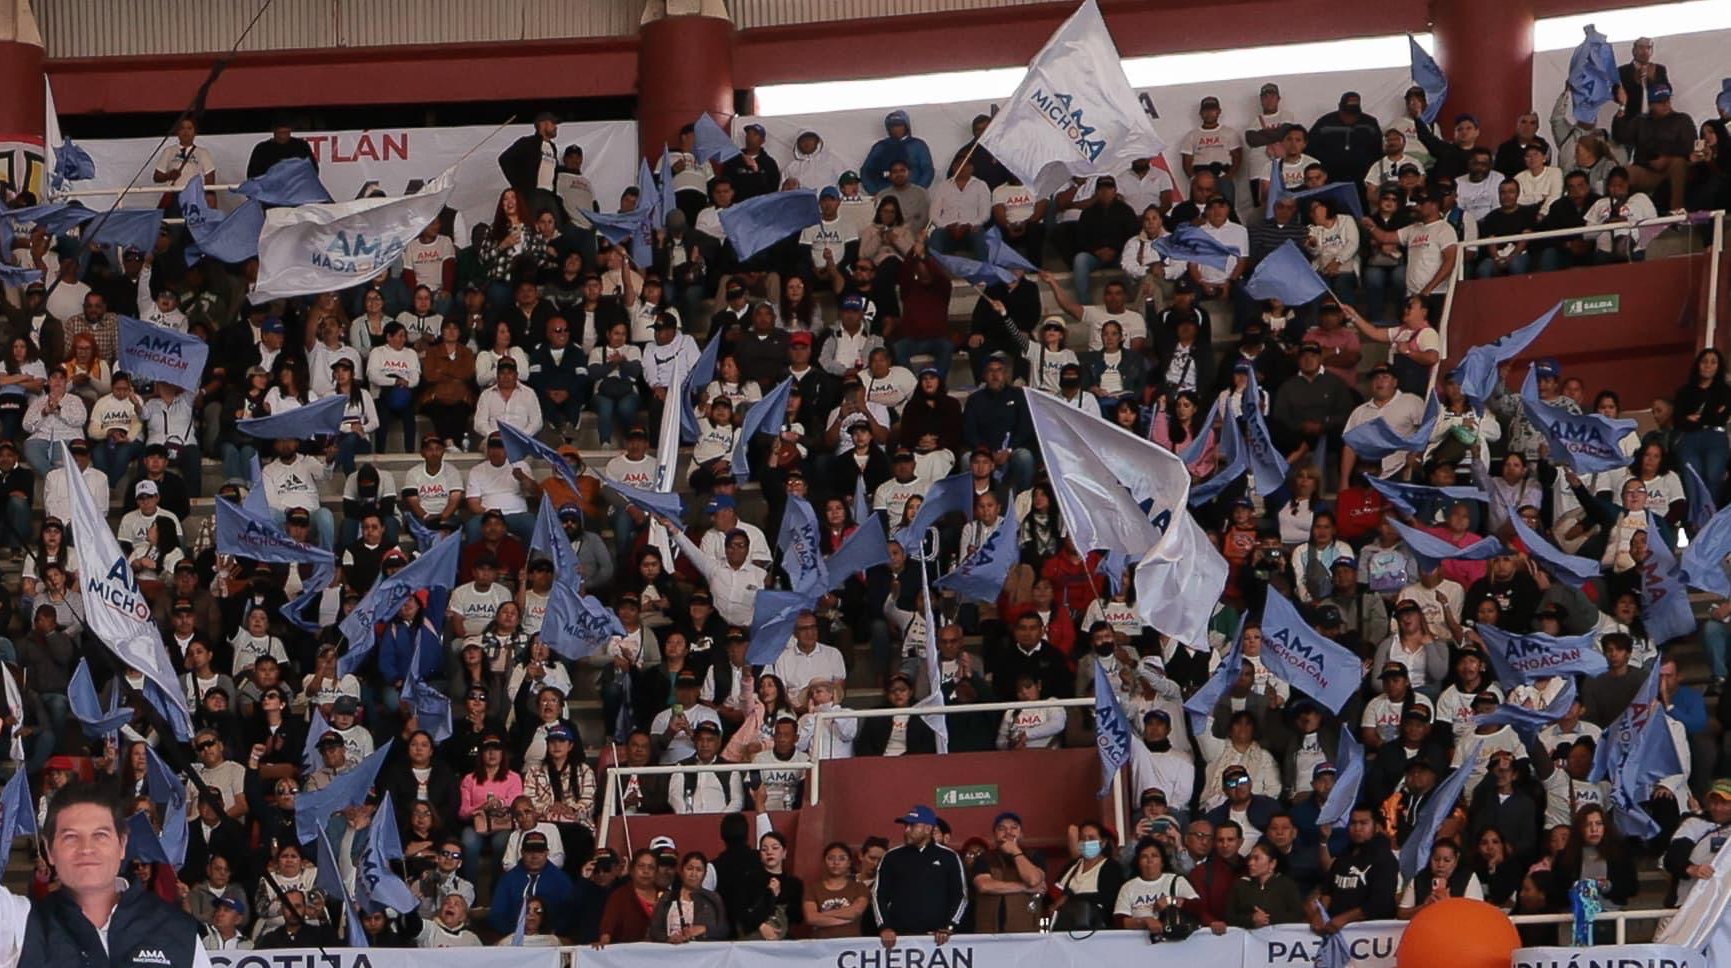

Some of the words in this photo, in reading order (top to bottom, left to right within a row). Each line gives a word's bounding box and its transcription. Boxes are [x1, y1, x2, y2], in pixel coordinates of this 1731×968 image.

[1030, 88, 1089, 158] MICHOA
[1054, 92, 1107, 164] AMA
[310, 128, 408, 163] TLÁN
[1199, 137, 1220, 145] AMA
[1006, 196, 1030, 205] AMA
[816, 231, 839, 240] AMA
[1411, 235, 1430, 244] AMA
[417, 250, 439, 259] AMA
[1583, 300, 1613, 310] SALIDA
[408, 323, 432, 333] AA
[136, 335, 182, 358] AMA
[384, 360, 408, 369] AMA
[870, 383, 894, 393] AMA
[103, 410, 129, 420] AMA
[708, 431, 733, 443] AMA
[1550, 420, 1602, 444] AMA
[623, 473, 649, 482] AMA
[419, 485, 444, 494] AMA
[893, 493, 910, 501] AM
[88, 577, 151, 620] MICHO
[468, 603, 495, 613] AMA
[1104, 612, 1135, 622] AMA
[245, 641, 269, 654] AMA
[1273, 627, 1325, 671] AMA
[1505, 639, 1550, 660] AM
[1510, 649, 1581, 672] CHOACAN
[1457, 707, 1474, 717] AM
[1015, 716, 1041, 725] AMA
[1378, 714, 1401, 724] AM
[767, 773, 797, 783] AMA
[958, 792, 991, 801] SALIDA
[1575, 791, 1599, 801] MA
[138, 950, 166, 960] AMA
